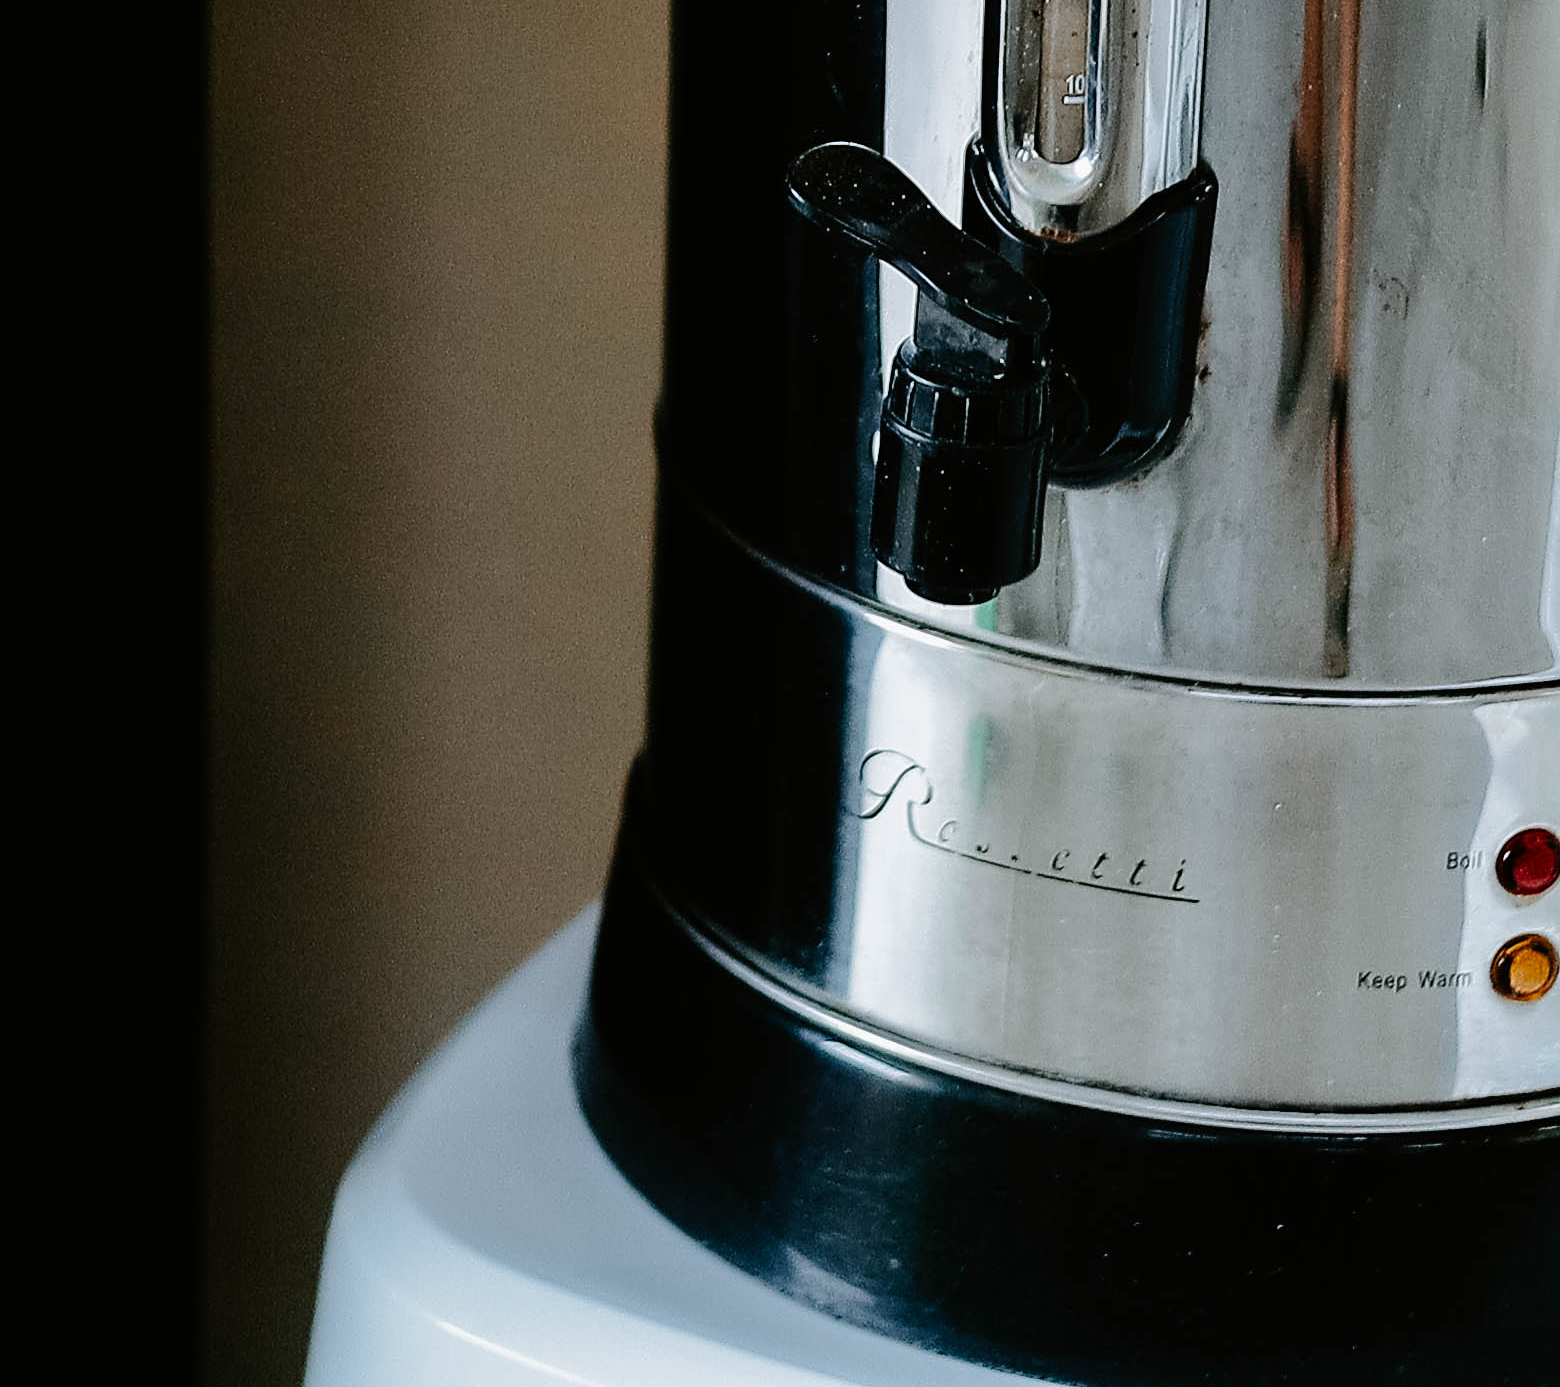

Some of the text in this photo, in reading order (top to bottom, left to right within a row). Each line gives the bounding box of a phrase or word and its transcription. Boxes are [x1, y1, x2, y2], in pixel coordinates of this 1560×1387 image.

[1064, 74, 1086, 95] 10
[1446, 851, 1482, 872] Boil
[1356, 970, 1473, 993] Keep Warm
